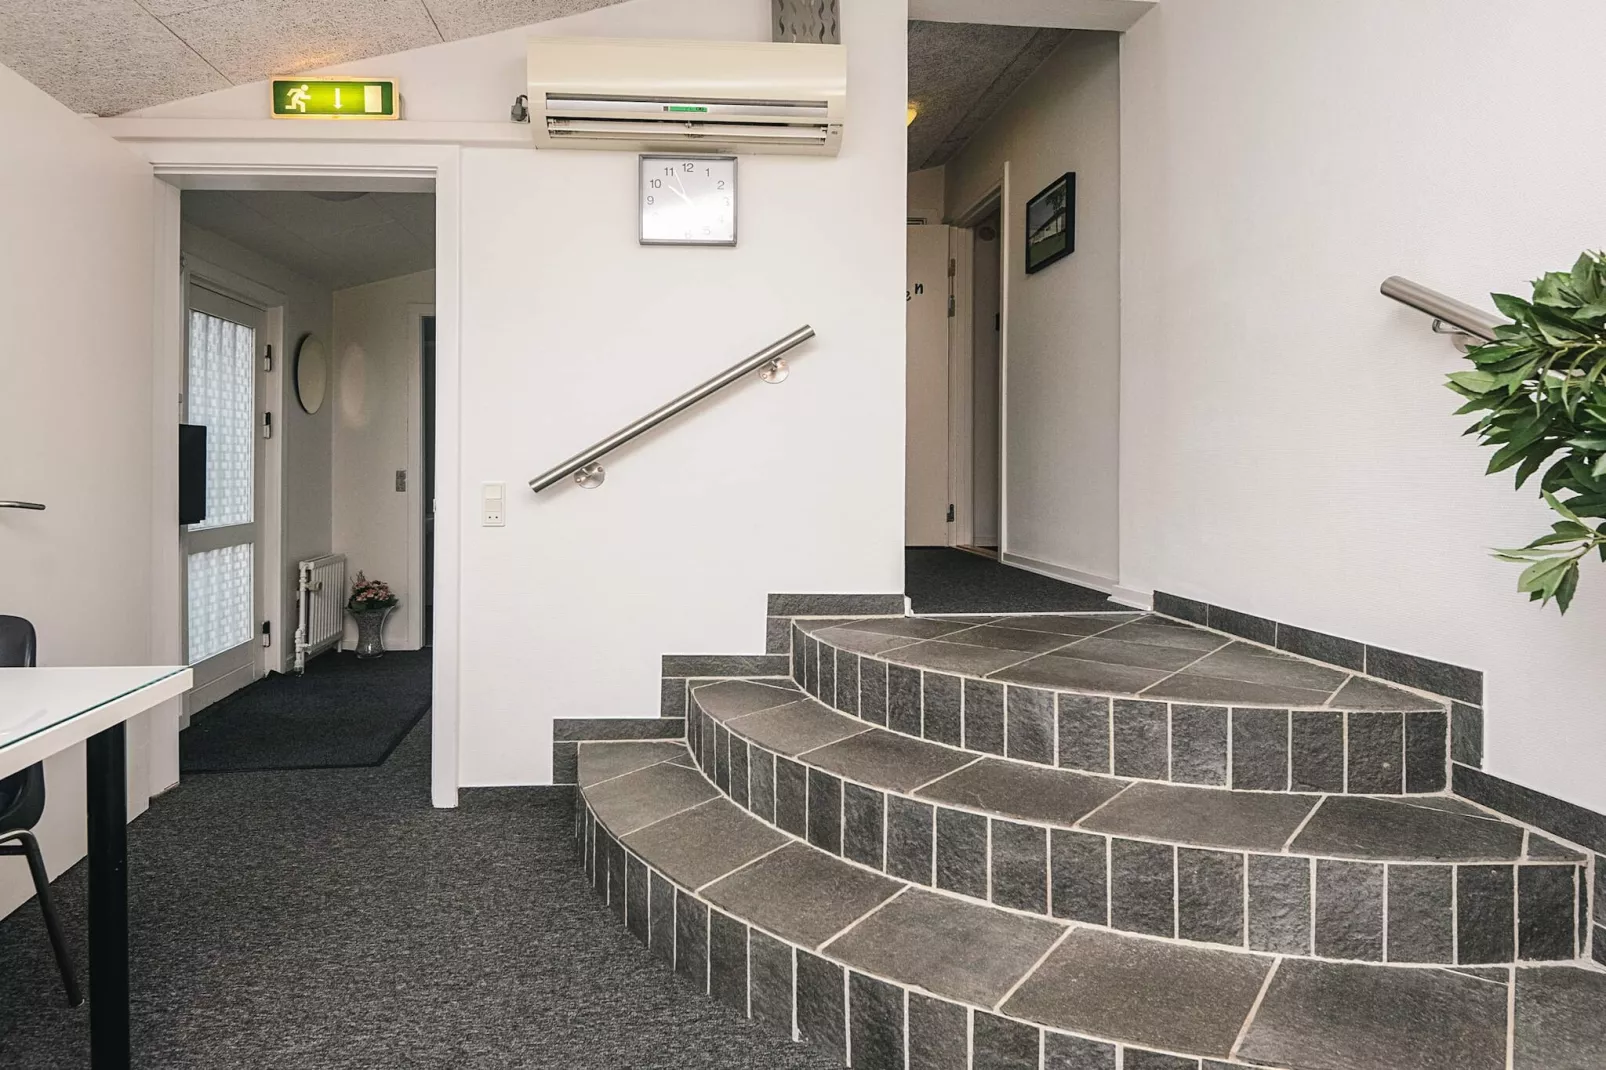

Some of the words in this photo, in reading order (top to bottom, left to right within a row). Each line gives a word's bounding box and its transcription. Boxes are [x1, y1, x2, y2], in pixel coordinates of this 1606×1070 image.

[664, 167, 674, 176] 11
[682, 163, 694, 172] 12
[705, 168, 710, 177] 1
[650, 179, 662, 188] 10
[717, 180, 725, 190] 2
[647, 195, 655, 205] 9
